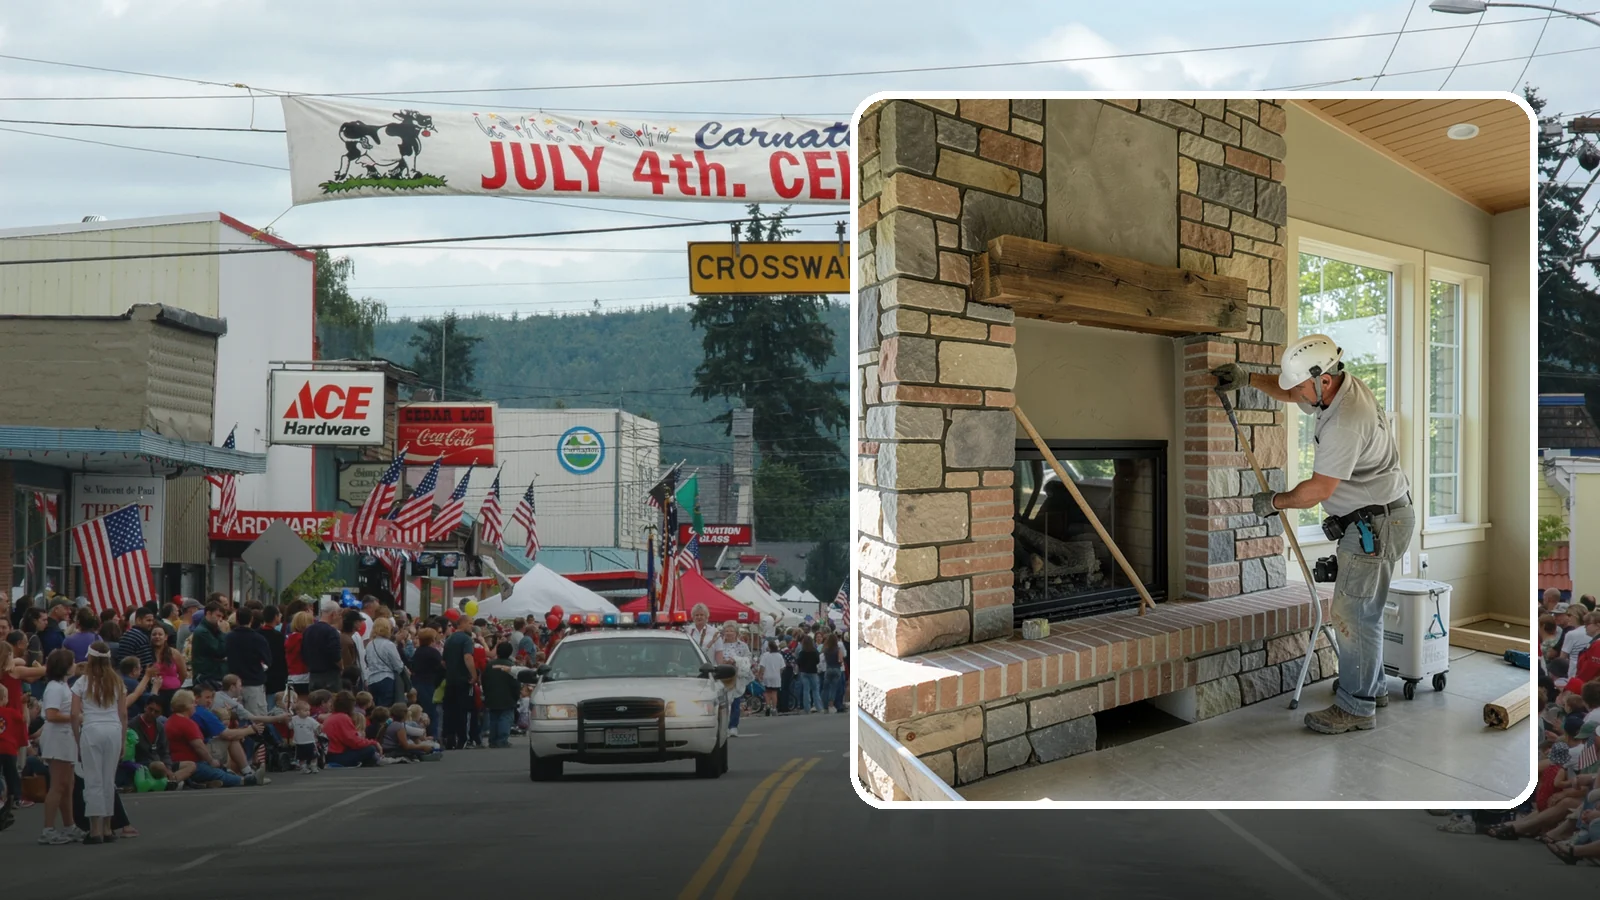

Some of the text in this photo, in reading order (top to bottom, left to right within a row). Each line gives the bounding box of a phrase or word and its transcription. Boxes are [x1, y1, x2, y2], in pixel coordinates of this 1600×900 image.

[481, 141, 605, 193] JULY
[632, 149, 746, 198] 4th.
[697, 254, 850, 280] CROSSWA
[283, 380, 373, 420] ACE
[406, 409, 452, 421] CEDAR
[284, 421, 371, 436] Hardware
[353, 466, 385, 480] Simpl
[96, 485, 124, 495] Vincent
[126, 486, 135, 495] de
[137, 486, 155, 495] Paul
[81, 503, 153, 522] THT
[688, 526, 741, 535] CRNATION
[699, 535, 730, 543] GLASS
